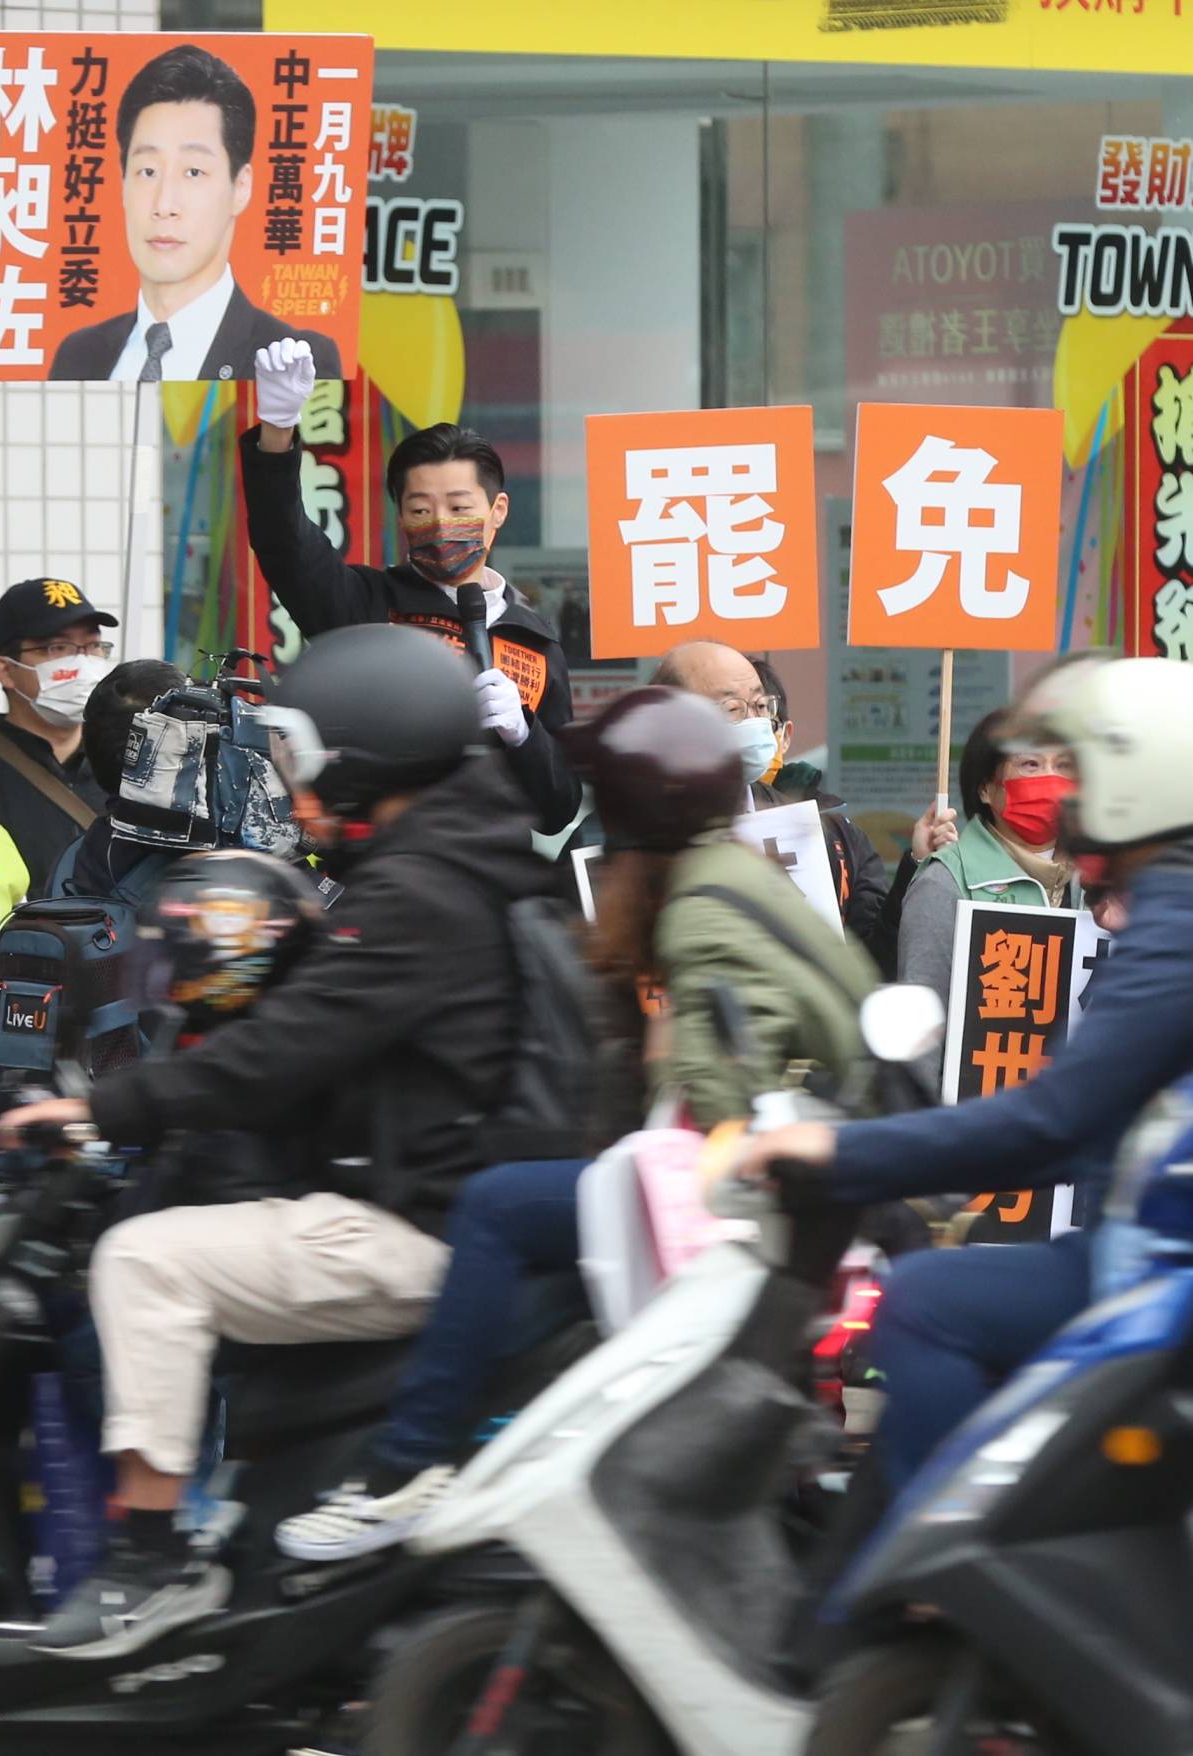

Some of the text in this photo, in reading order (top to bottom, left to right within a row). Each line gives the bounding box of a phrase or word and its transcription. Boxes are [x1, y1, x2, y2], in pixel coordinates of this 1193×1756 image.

[60, 47, 108, 308] 力挺好立委
[265, 50, 310, 256] 中正萬華
[312, 68, 358, 256] 一月九日
[272, 264, 339, 281] TAIWAN
[277, 281, 335, 299] ULTRA
[617, 443, 788, 627] 罷
[876, 434, 1031, 619] 免
[503, 644, 538, 663] TOGETHER
[6, 1005, 47, 1030] LiveU
